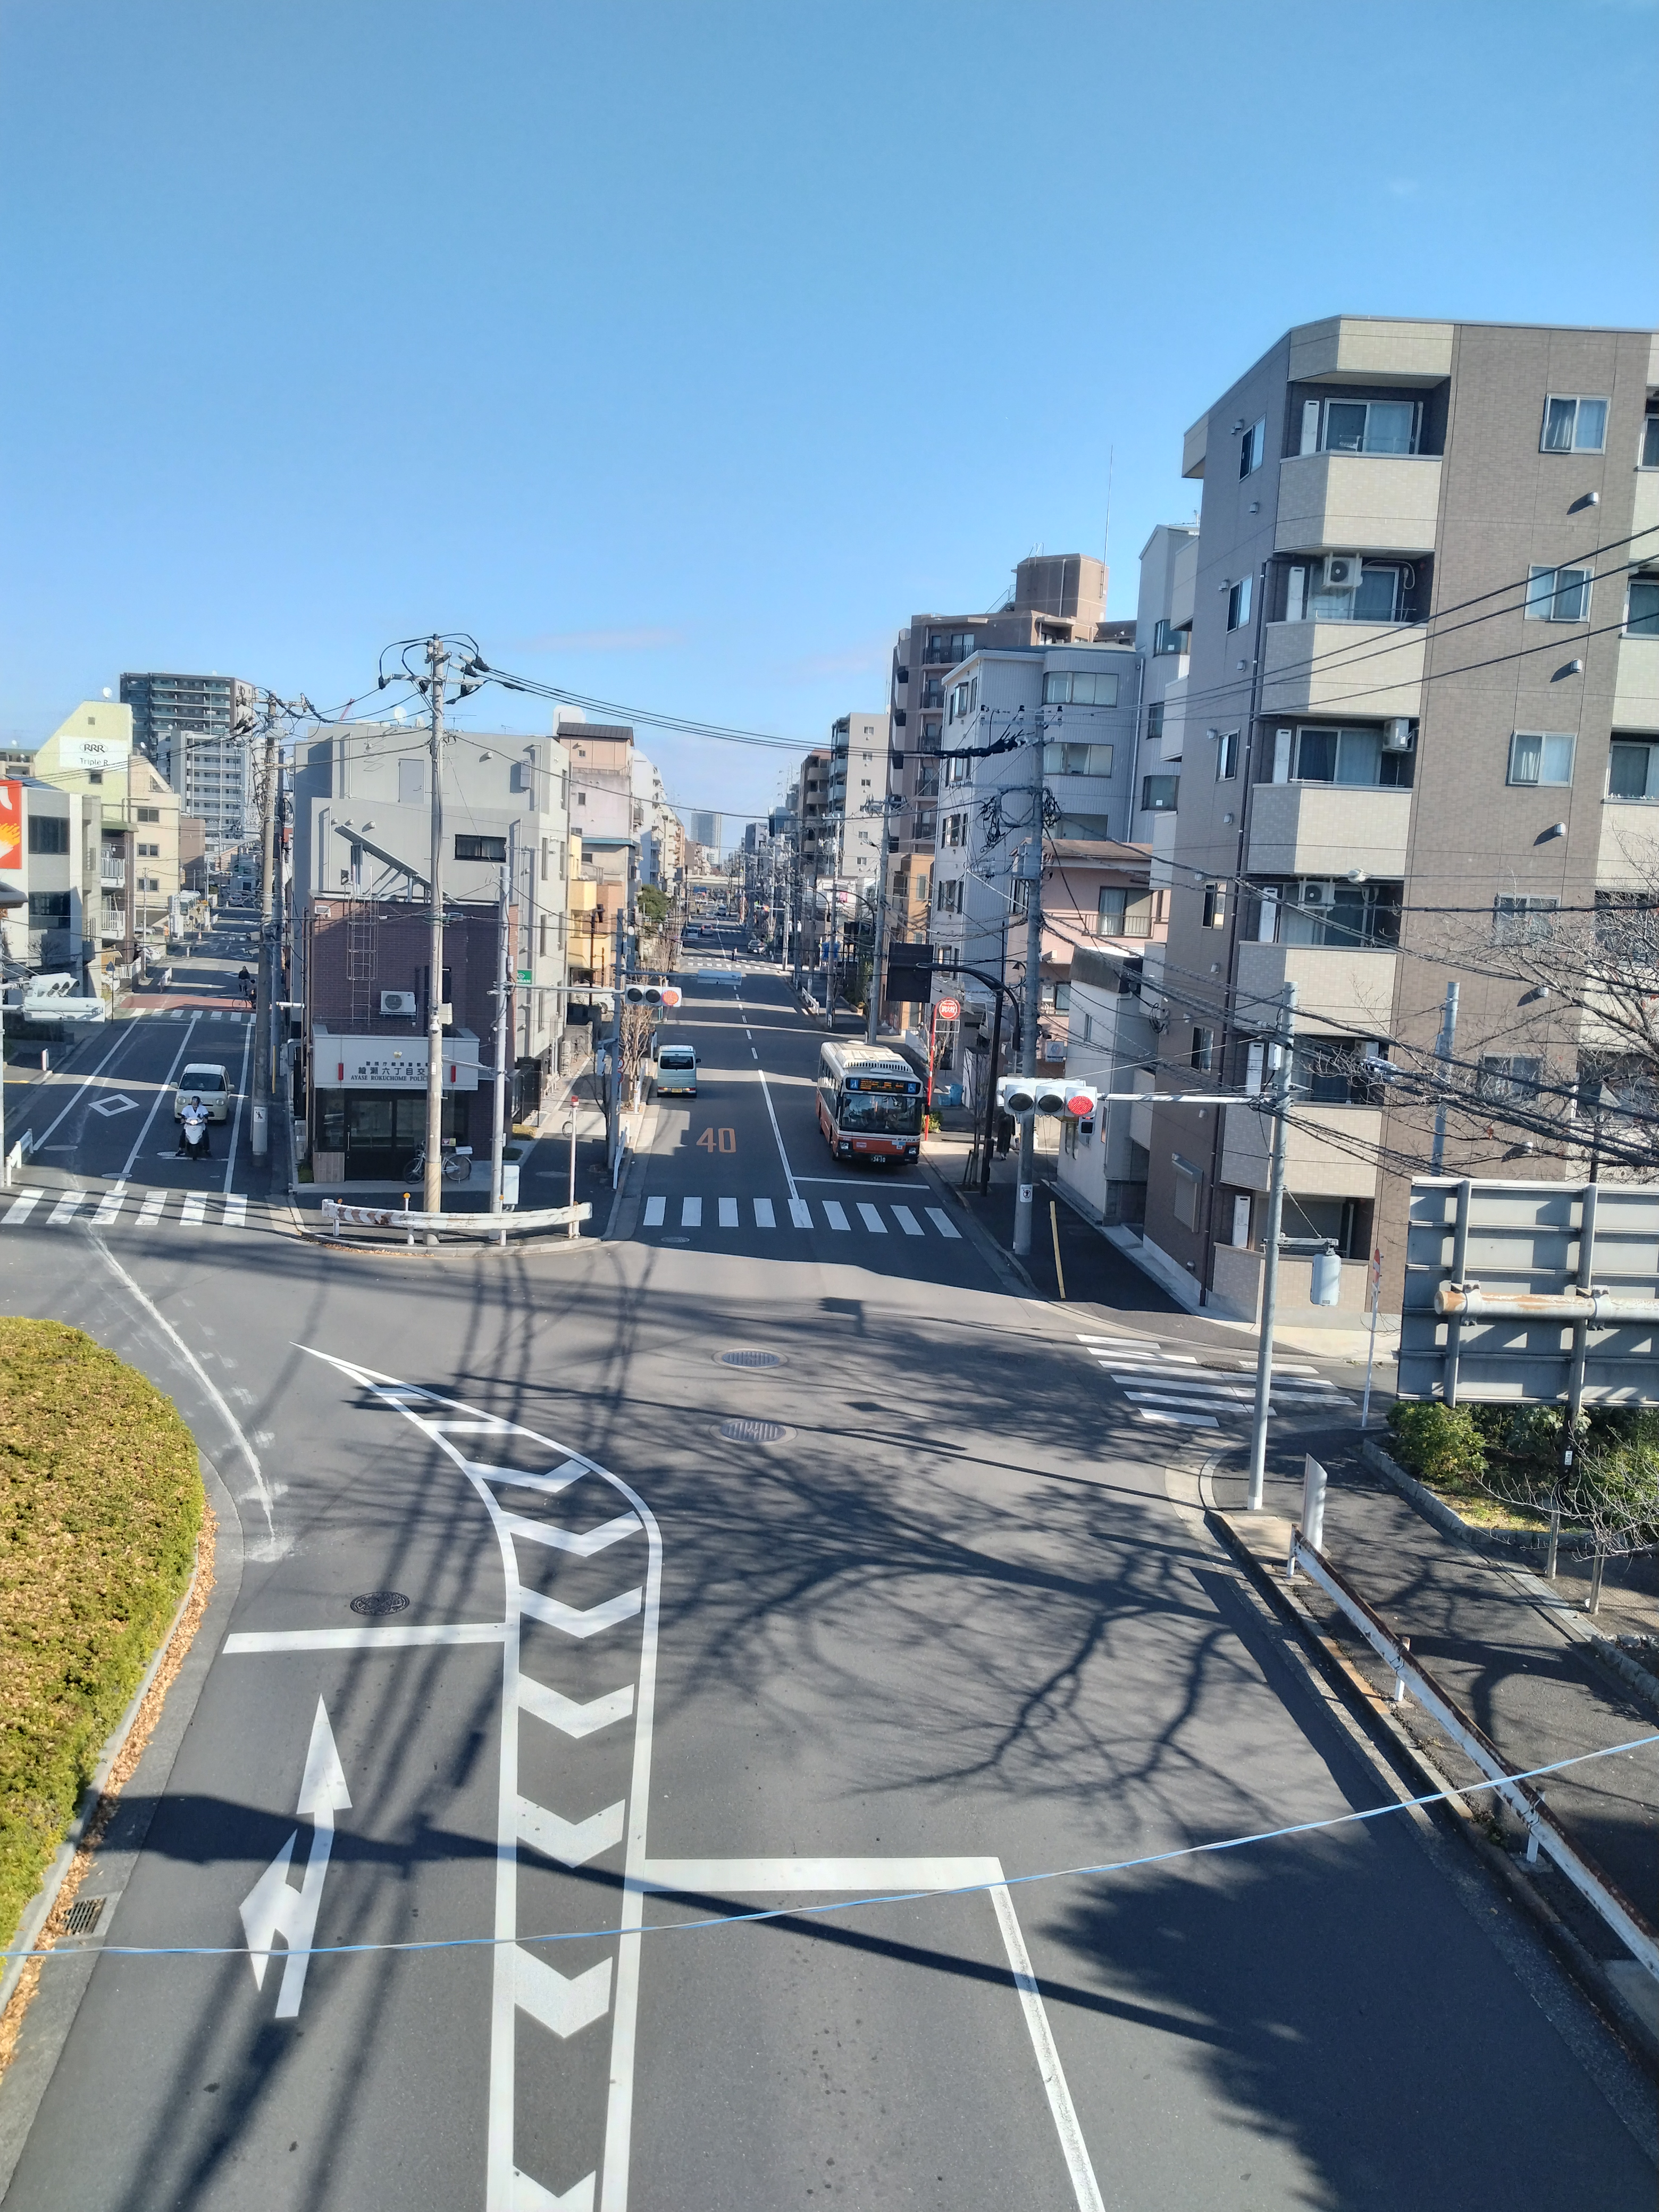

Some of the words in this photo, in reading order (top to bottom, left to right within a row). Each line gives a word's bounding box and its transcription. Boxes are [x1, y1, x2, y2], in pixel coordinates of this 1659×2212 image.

[84, 743, 105, 753] RRR
[80, 758, 102, 766] Triple
[358, 1067, 425, 1076] 綾瀬六丁目交
[696, 1127, 736, 1153] 40
